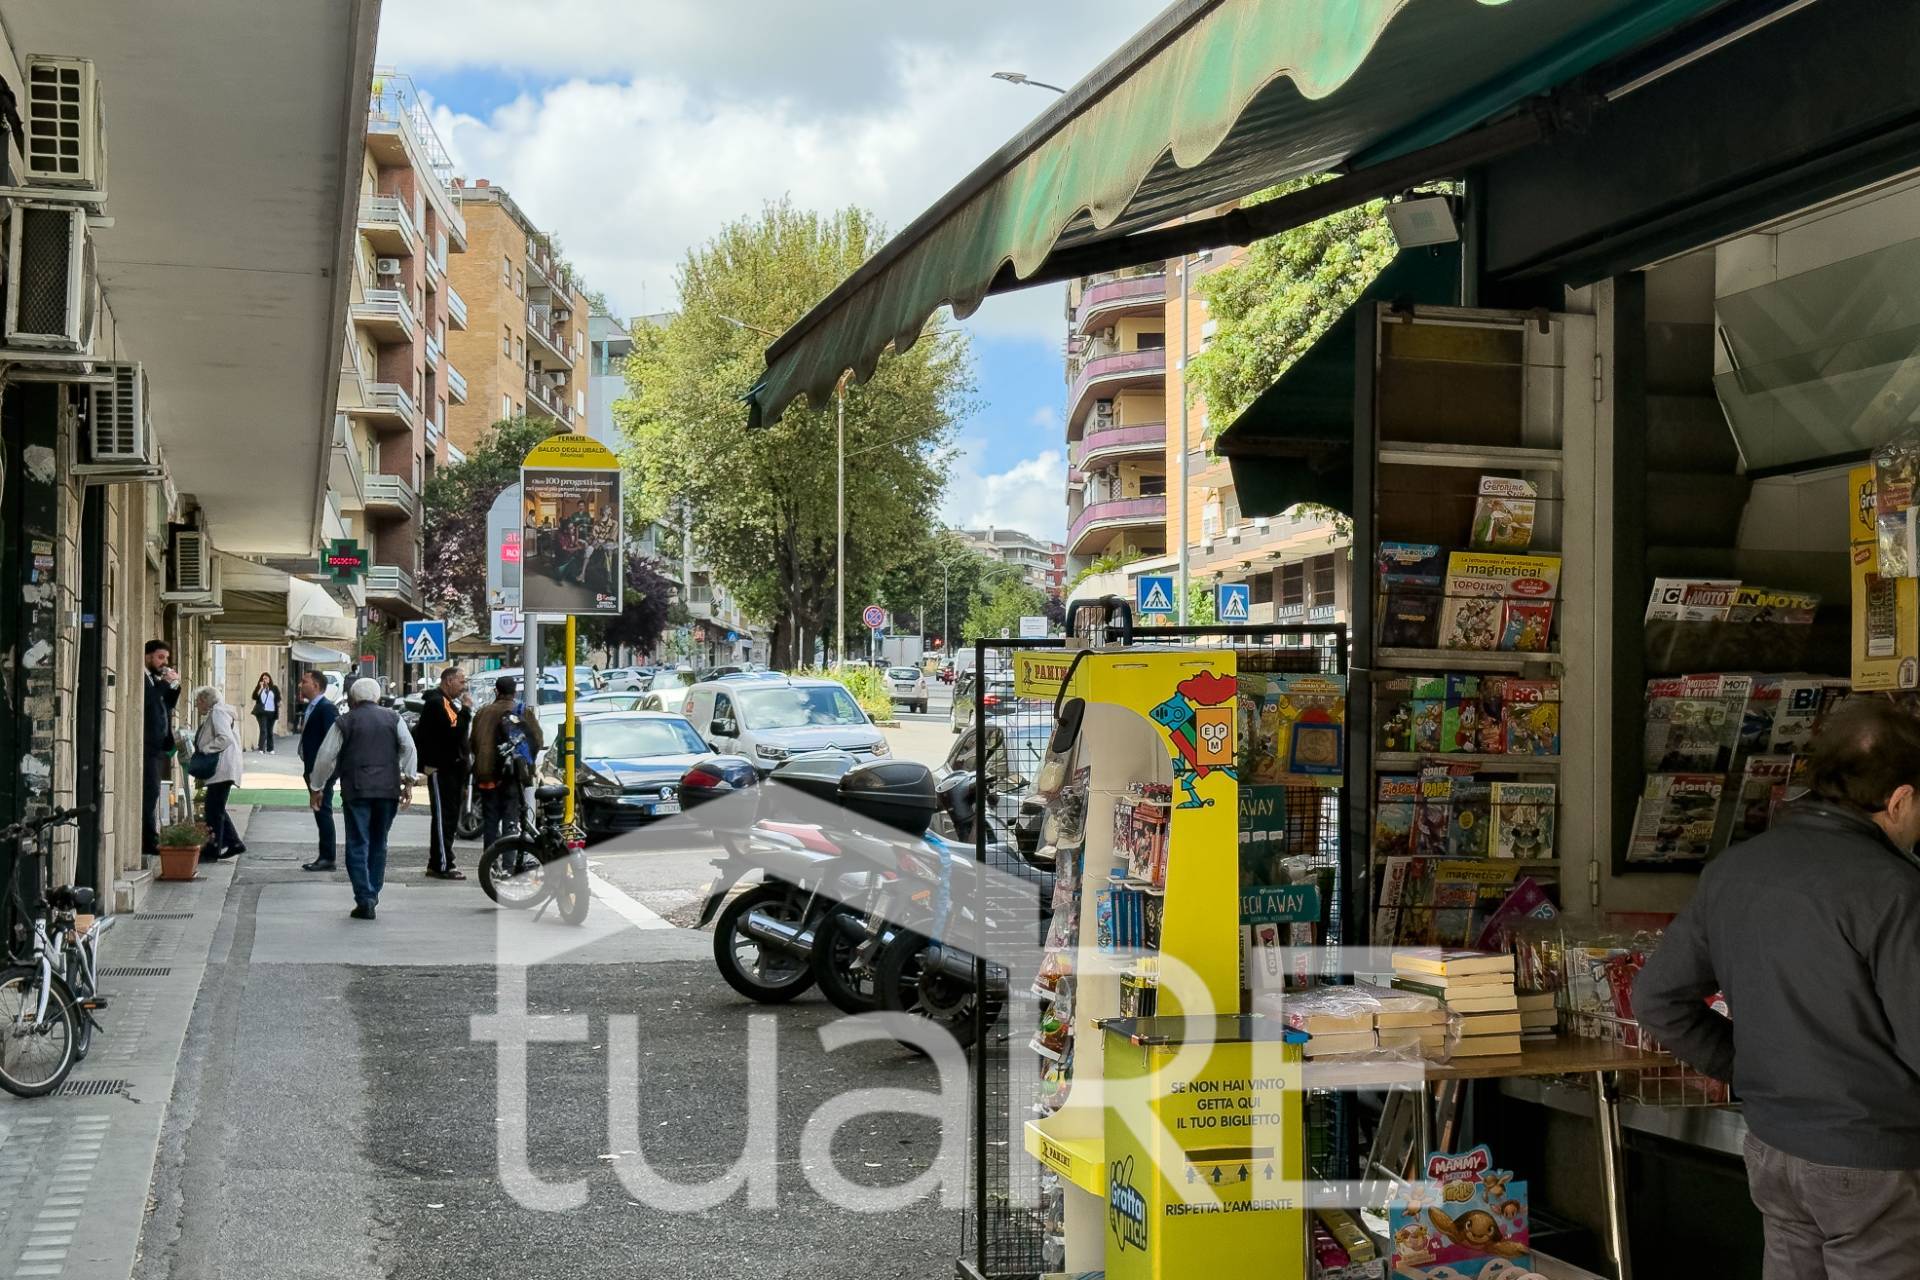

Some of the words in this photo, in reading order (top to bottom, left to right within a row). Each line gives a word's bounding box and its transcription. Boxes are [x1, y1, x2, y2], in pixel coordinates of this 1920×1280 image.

[545, 476, 560, 486] 100
[560, 478, 593, 488] progetti
[1466, 565, 1541, 577] magnetica!
[1453, 581, 1503, 592] TOPOLINO
[1239, 799, 1275, 817] AWAY
[1266, 894, 1305, 913] AWAY
[1171, 1082, 1186, 1094] SE
[1189, 1081, 1220, 1093] NON
[1222, 1080, 1245, 1092] HAI
[1249, 1078, 1286, 1090] VINTO
[1197, 1098, 1236, 1111] GETTA
[1238, 1097, 1261, 1110] QUI
[1176, 1118, 1187, 1129] IL
[1190, 1117, 1217, 1128] TUO
[1220, 1114, 1281, 1128] BIGLIETTO
[1435, 1156, 1482, 1175] MAMMY
[1111, 1180, 1143, 1222] Gratta
[1165, 1201, 1220, 1217] RISPETTA
[1223, 1199, 1294, 1214] L'AMBIENTE
